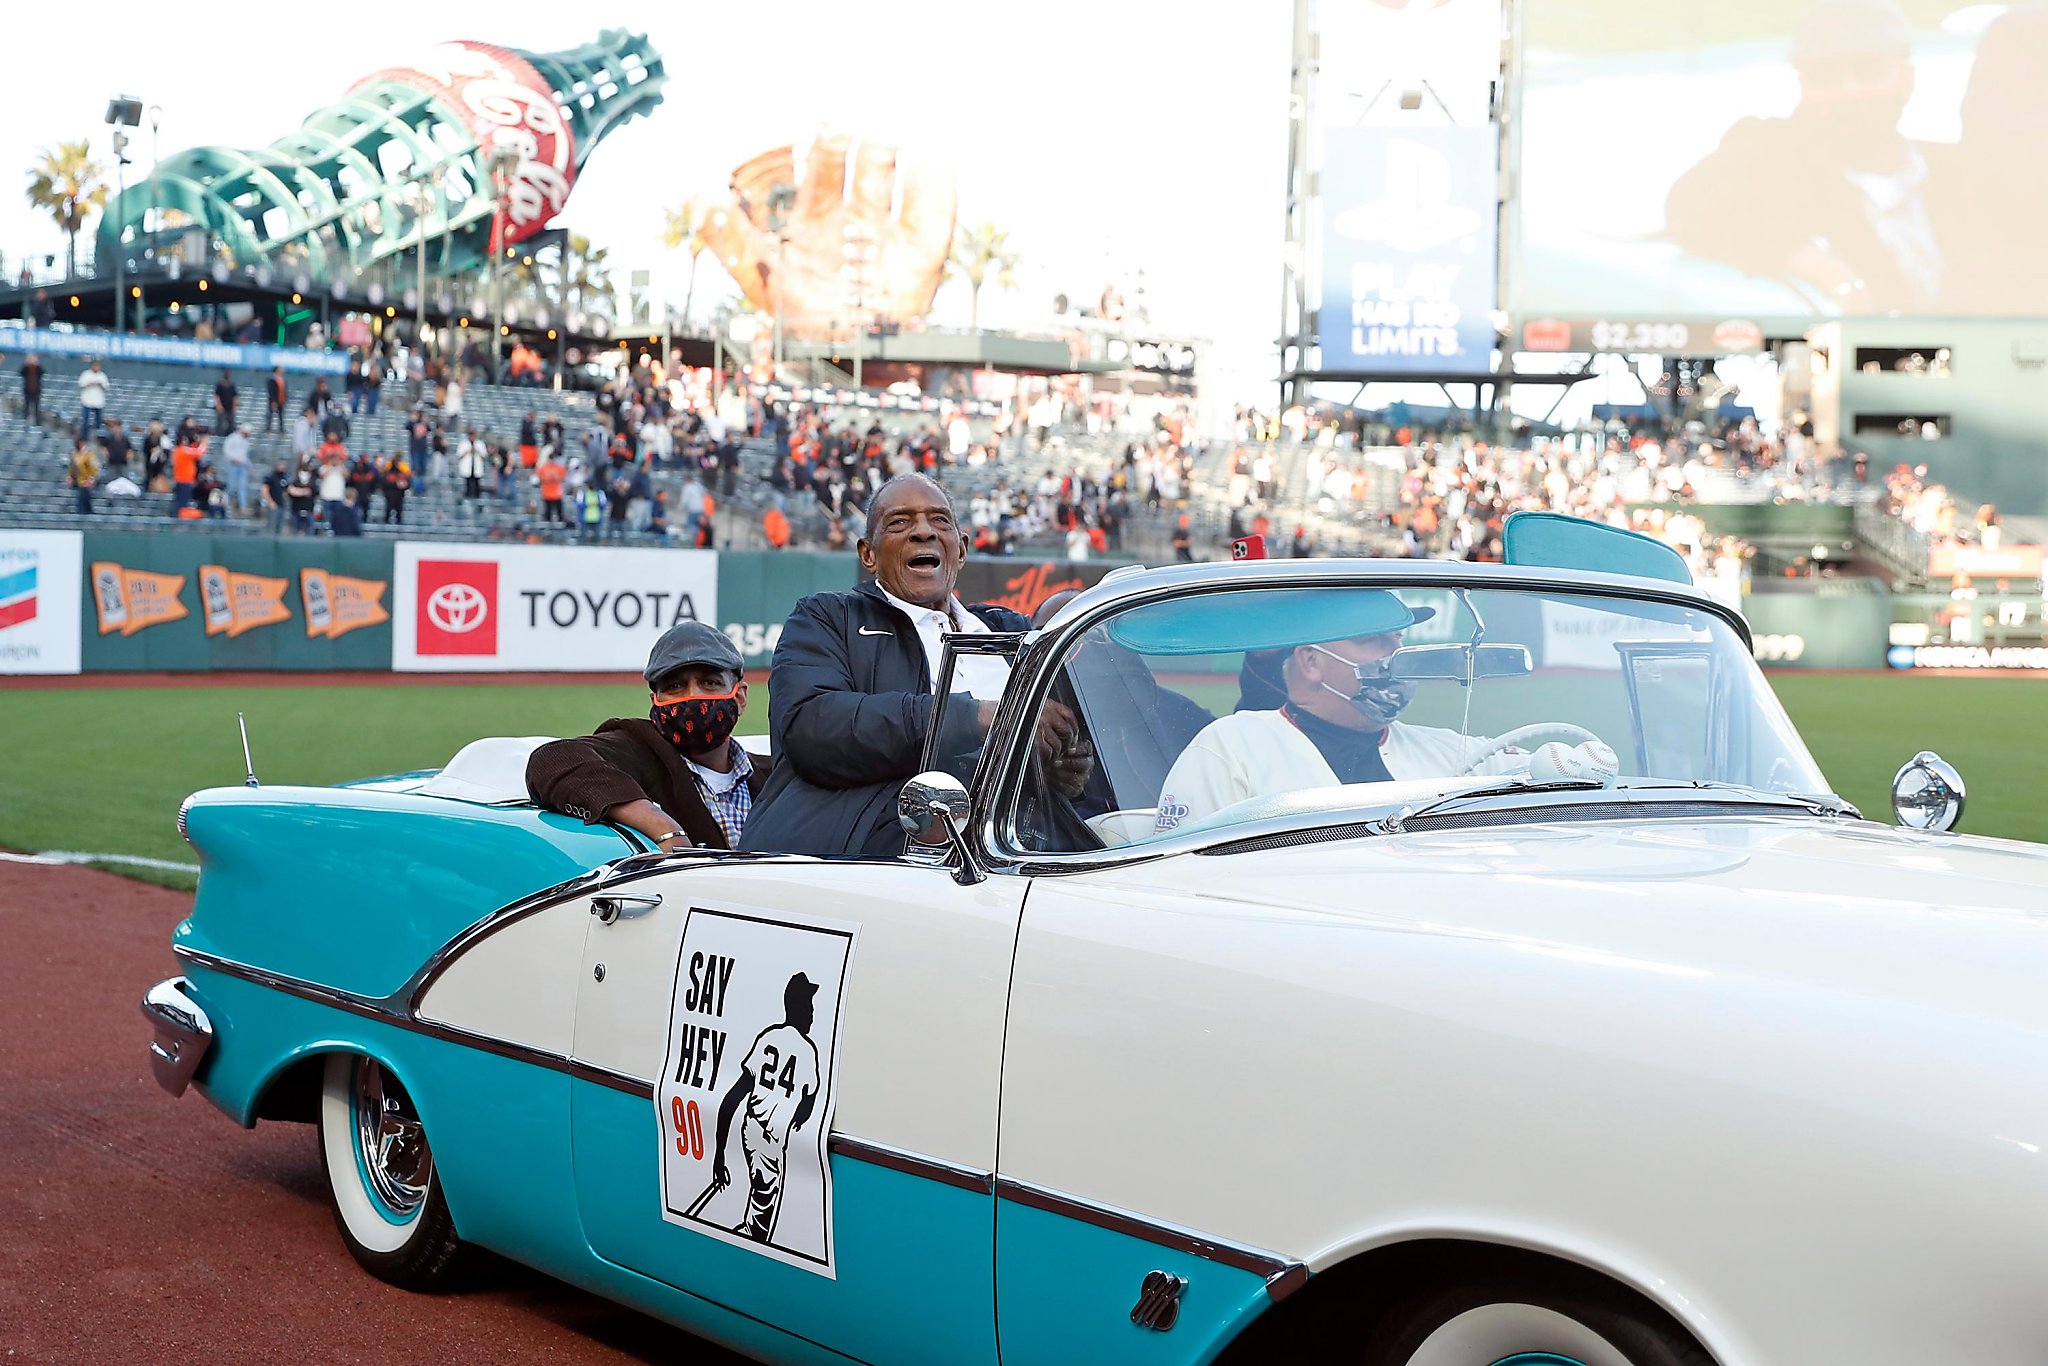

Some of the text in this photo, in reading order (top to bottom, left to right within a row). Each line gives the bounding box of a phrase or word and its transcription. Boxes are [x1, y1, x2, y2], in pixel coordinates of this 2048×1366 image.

[1351, 262, 1461, 300] PLAY
[1351, 300, 1411, 328] HAS
[520, 591, 698, 627] TOYOTA
[684, 951, 736, 1018] SAY
[674, 1023, 728, 1092] HEY
[759, 1043, 798, 1099] 24
[671, 1095, 704, 1161] 90
